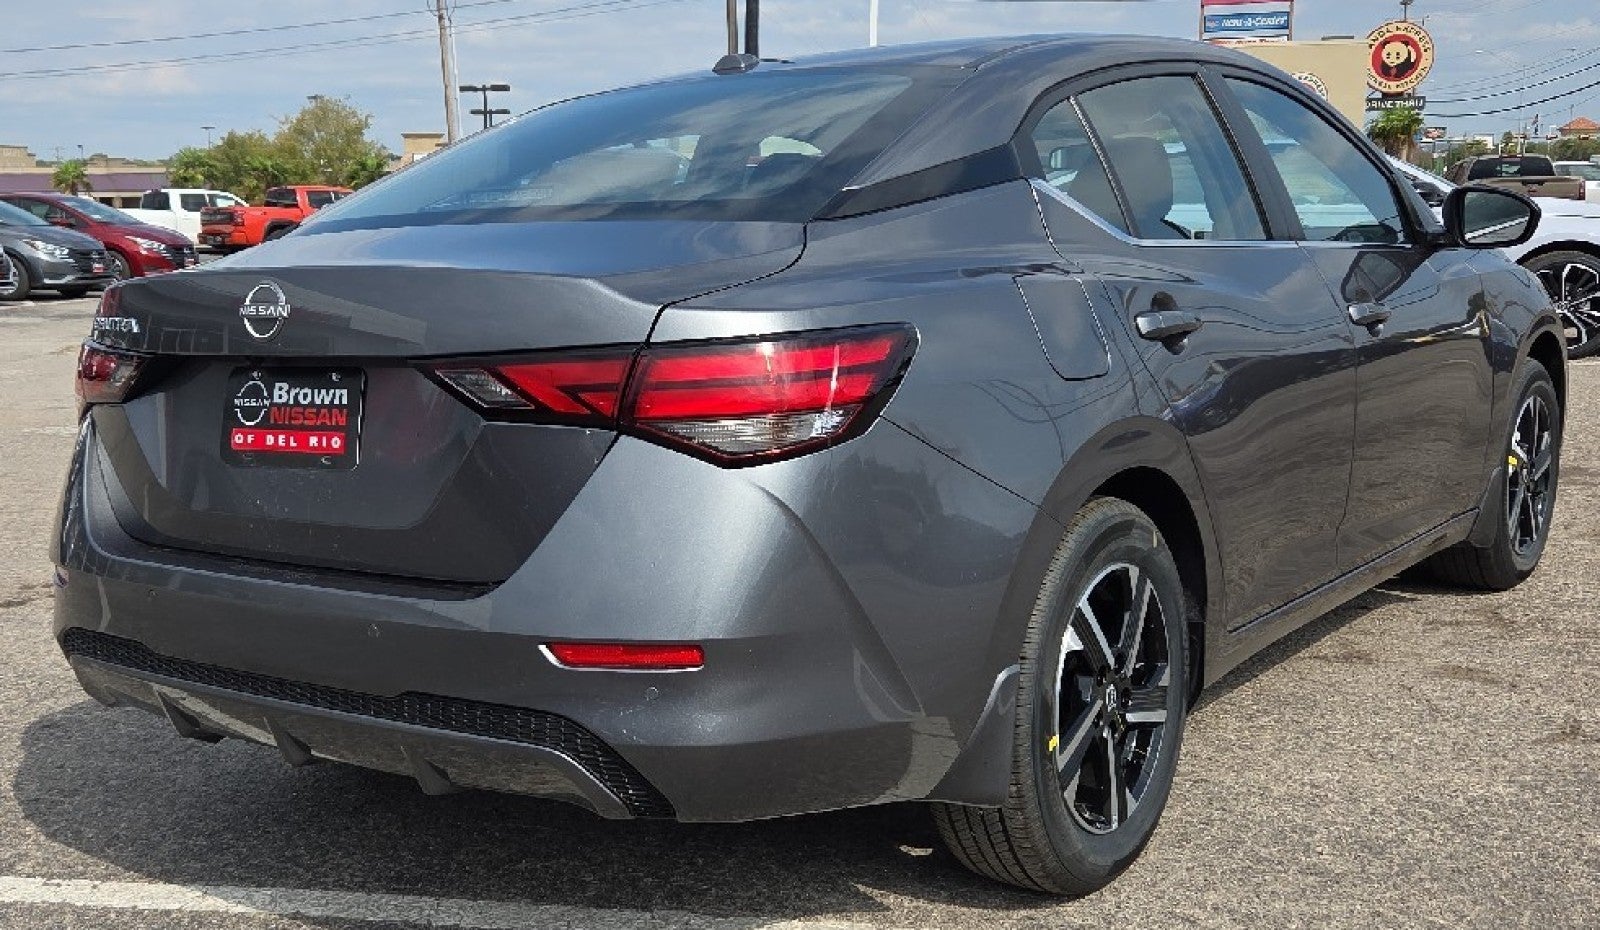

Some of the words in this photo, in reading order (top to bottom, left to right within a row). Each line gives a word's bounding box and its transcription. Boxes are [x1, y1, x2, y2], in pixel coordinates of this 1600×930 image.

[1395, 98, 1424, 108] THRU
[239, 304, 291, 317] NISSAN
[273, 382, 348, 405] Brown
[234, 398, 271, 408] NISSAN
[269, 406, 348, 426] NISSAN
[234, 432, 256, 444] OF
[265, 434, 298, 447] DEL
[308, 436, 341, 449] RIO
